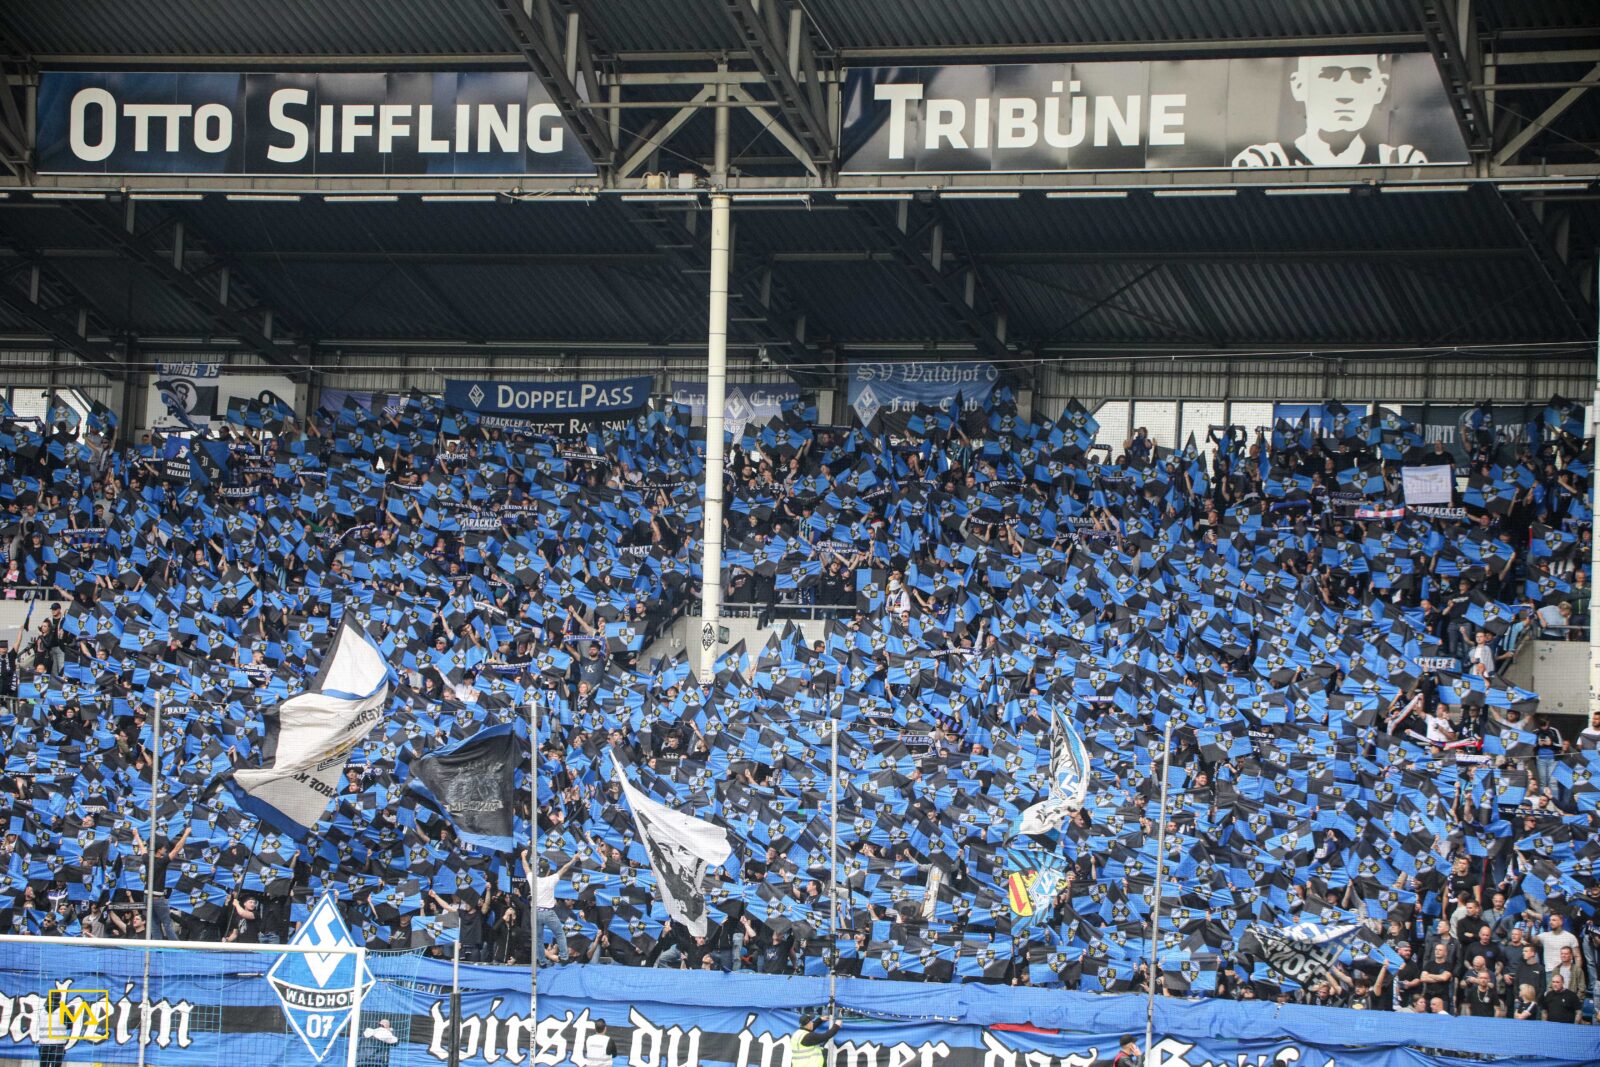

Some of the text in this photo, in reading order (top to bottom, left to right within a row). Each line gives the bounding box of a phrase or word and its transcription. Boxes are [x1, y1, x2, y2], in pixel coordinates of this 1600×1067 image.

[69, 87, 564, 163] OTTO SIFFLING
[874, 80, 1186, 160] TRIBÜNE
[903, 363, 980, 385] Waldhof
[986, 364, 999, 382] 0
[1424, 424, 1455, 443] DIRTY
[306, 1014, 335, 1039] 07
